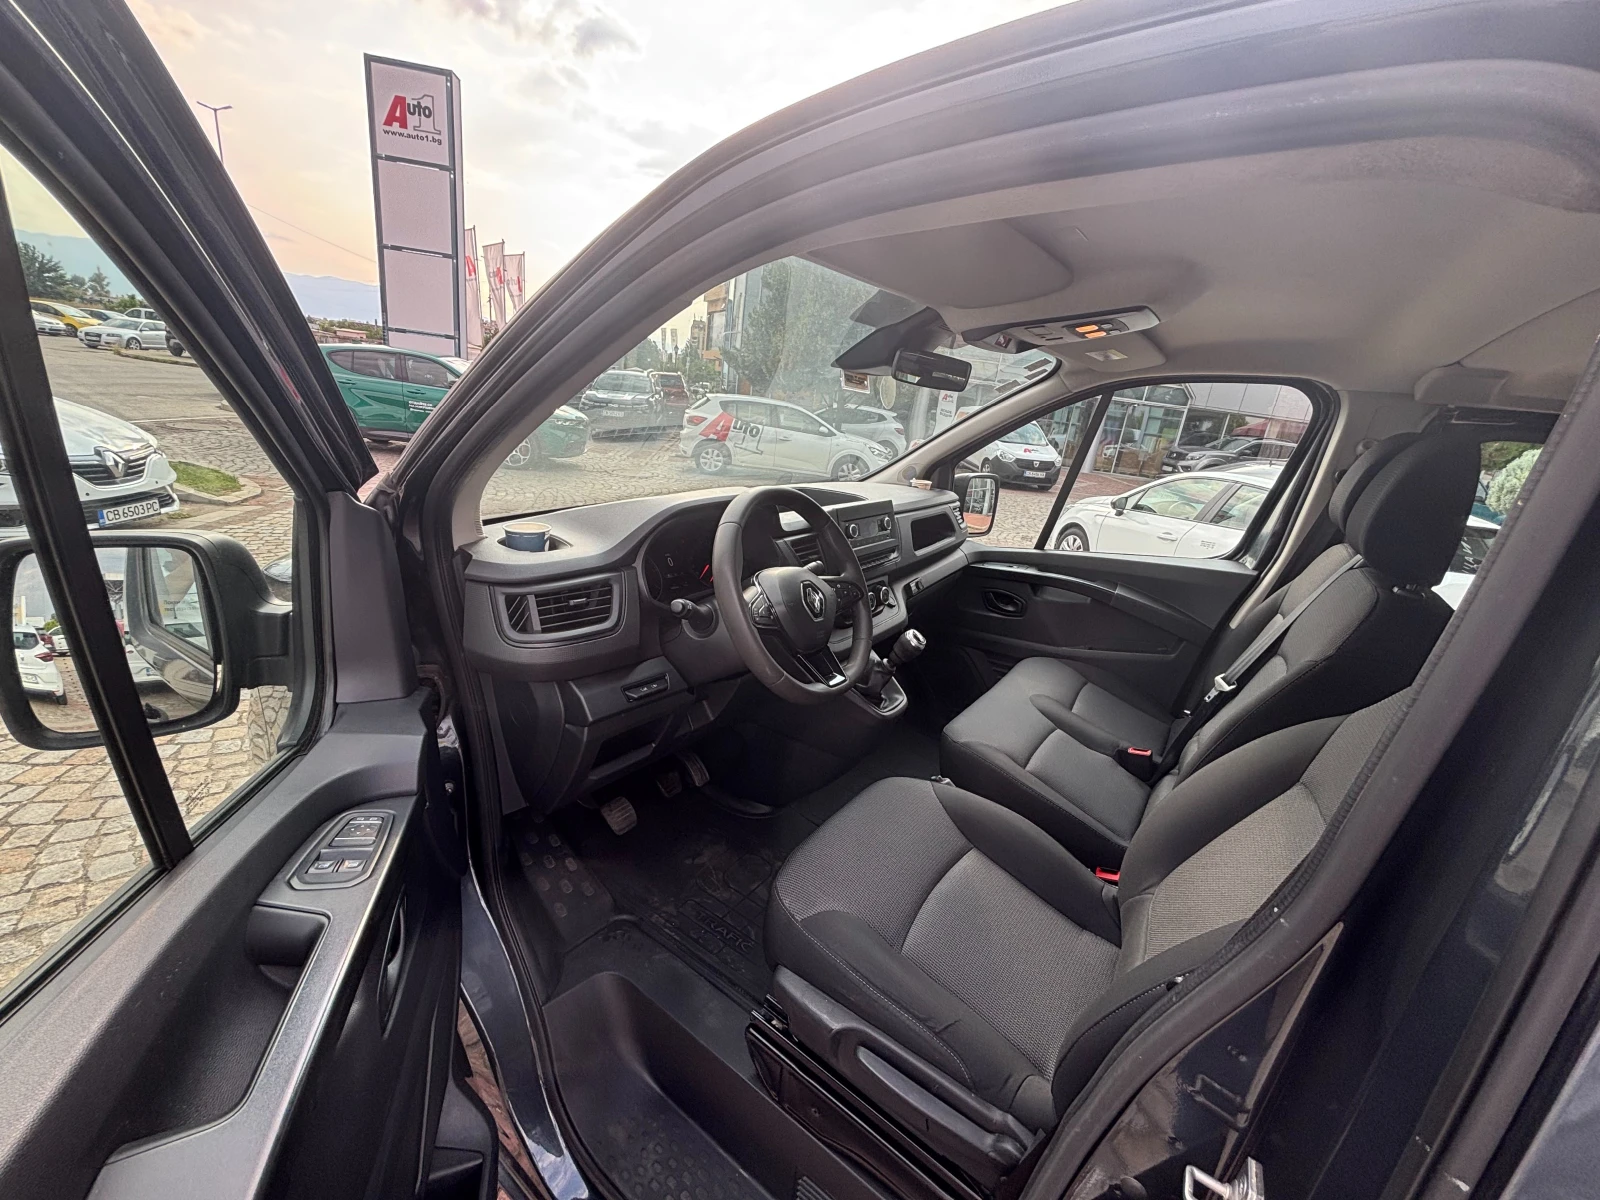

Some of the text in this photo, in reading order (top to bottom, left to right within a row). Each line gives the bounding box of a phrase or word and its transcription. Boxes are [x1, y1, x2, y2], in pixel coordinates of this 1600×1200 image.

[382, 129, 442, 145] www.auto1.bg
[106, 501, 158, 521] CB 6503 PC
[698, 909, 754, 953] TRAFIC
